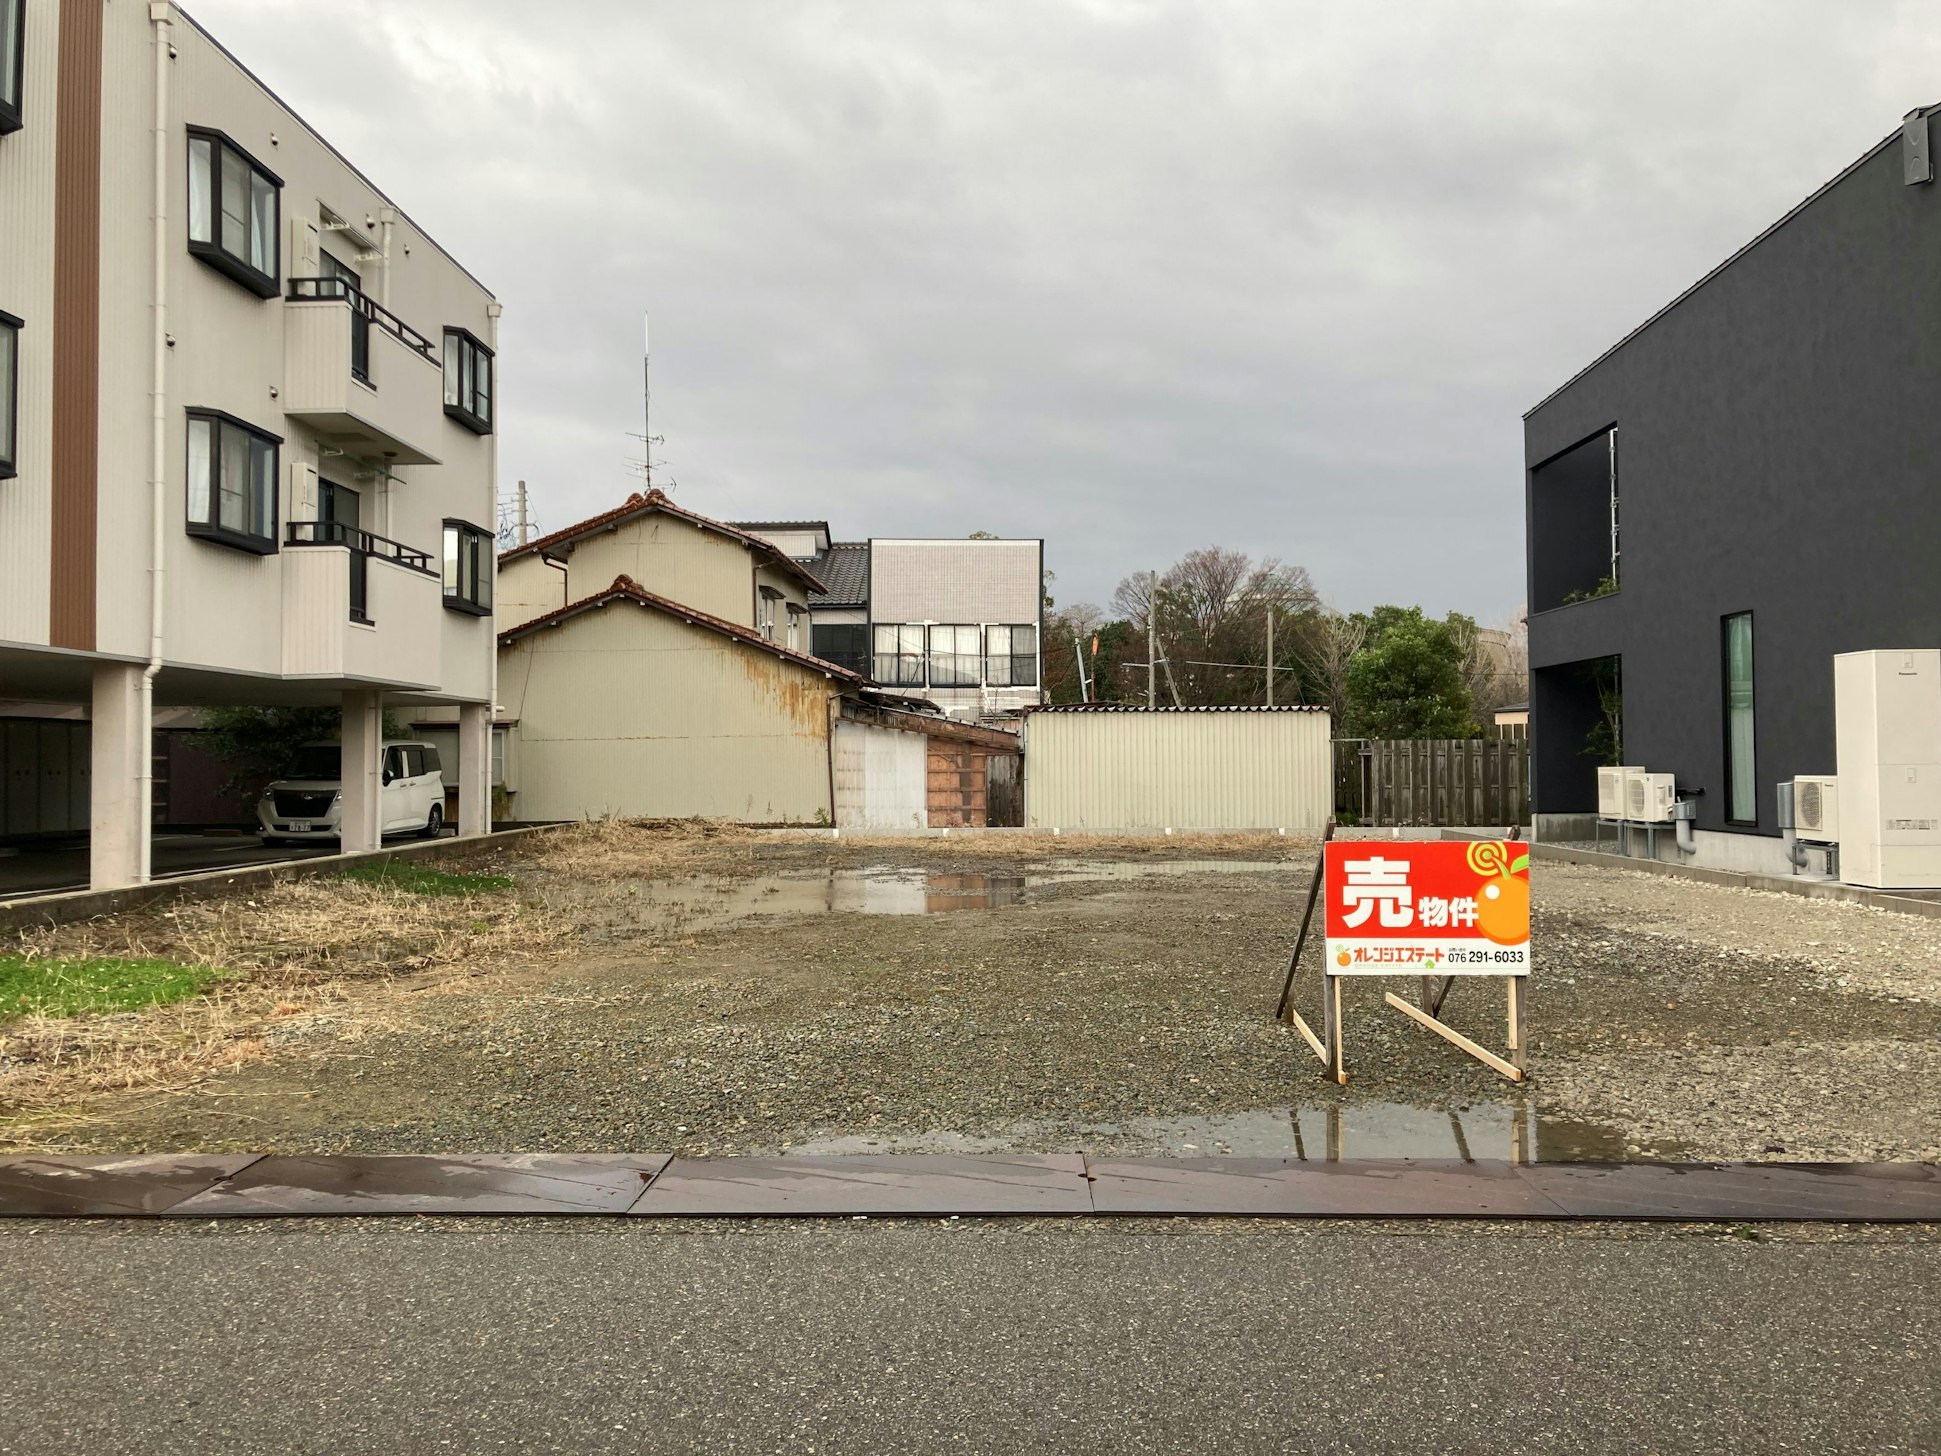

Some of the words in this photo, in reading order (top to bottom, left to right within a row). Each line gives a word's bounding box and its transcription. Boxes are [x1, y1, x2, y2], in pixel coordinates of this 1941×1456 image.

[1342, 856, 1479, 928] 売物件
[1353, 947, 1445, 963] オレンジエステート
[1448, 953, 1467, 963] 076
[1469, 951, 1524, 963] 291-6033
